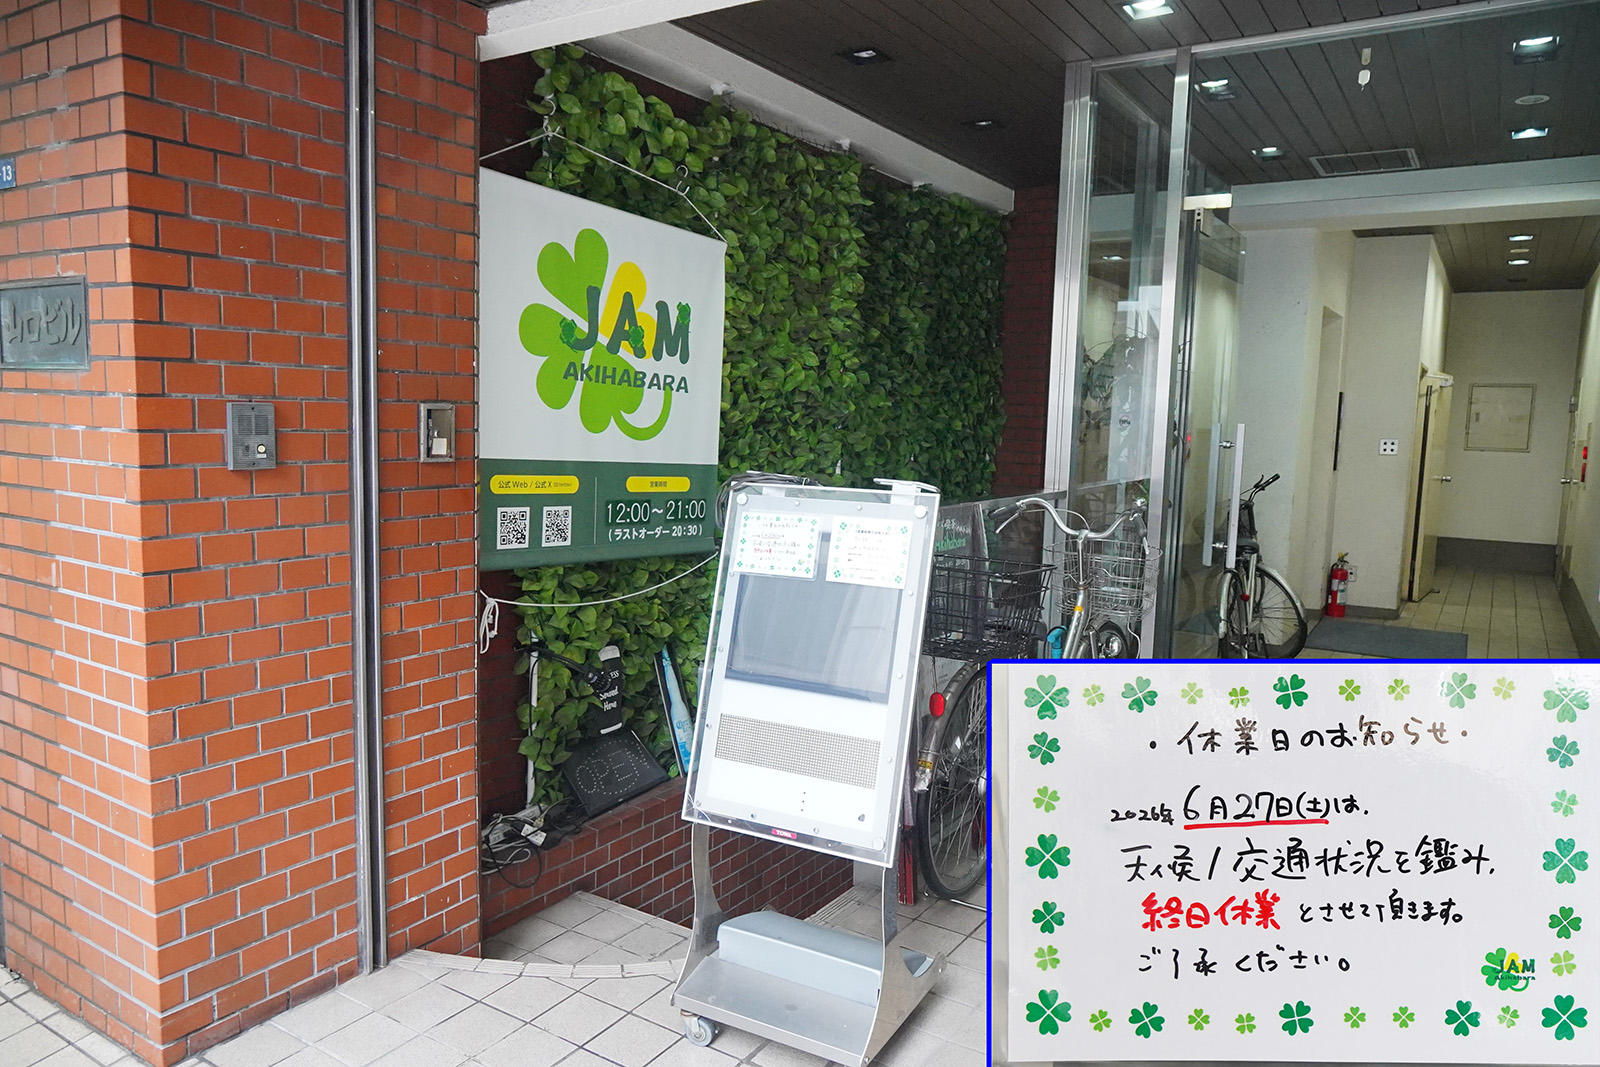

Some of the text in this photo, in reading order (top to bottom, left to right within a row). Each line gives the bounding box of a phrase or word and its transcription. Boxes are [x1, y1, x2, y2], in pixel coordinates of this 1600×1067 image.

[559, 285, 691, 364] JAM
[562, 361, 689, 394] AKIHABARA
[1491, 958, 1536, 974] JAM
